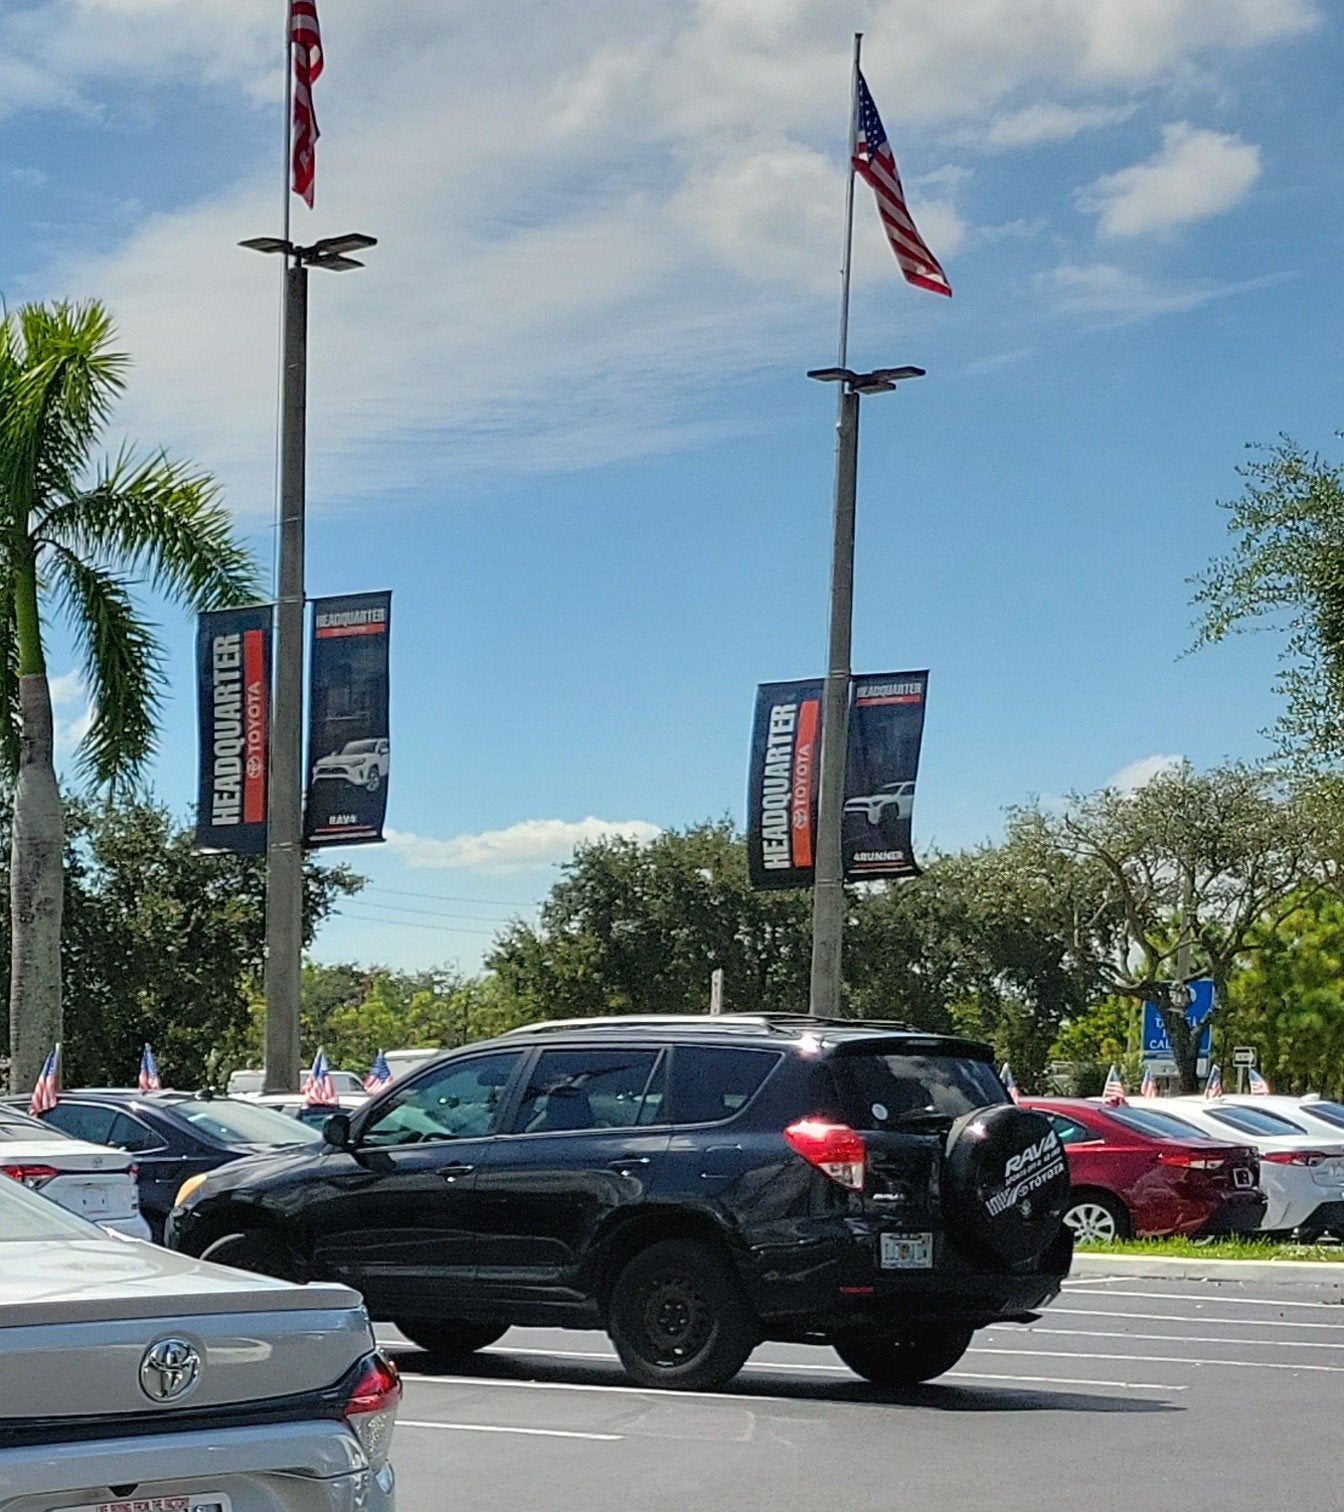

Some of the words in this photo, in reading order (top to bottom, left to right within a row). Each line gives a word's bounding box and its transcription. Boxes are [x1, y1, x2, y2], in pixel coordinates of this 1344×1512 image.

[316, 608, 385, 628] HEADQUARTER
[247, 681, 262, 756] TOYOTA
[856, 682, 922, 698] HEADQUARTER
[212, 633, 245, 826] HEADQUARTER
[761, 703, 798, 869] HEADQUARTER
[795, 744, 811, 810] TOYOTA
[1004, 1129, 1058, 1178] RAV4
[1028, 1162, 1065, 1191] TOYOTA
